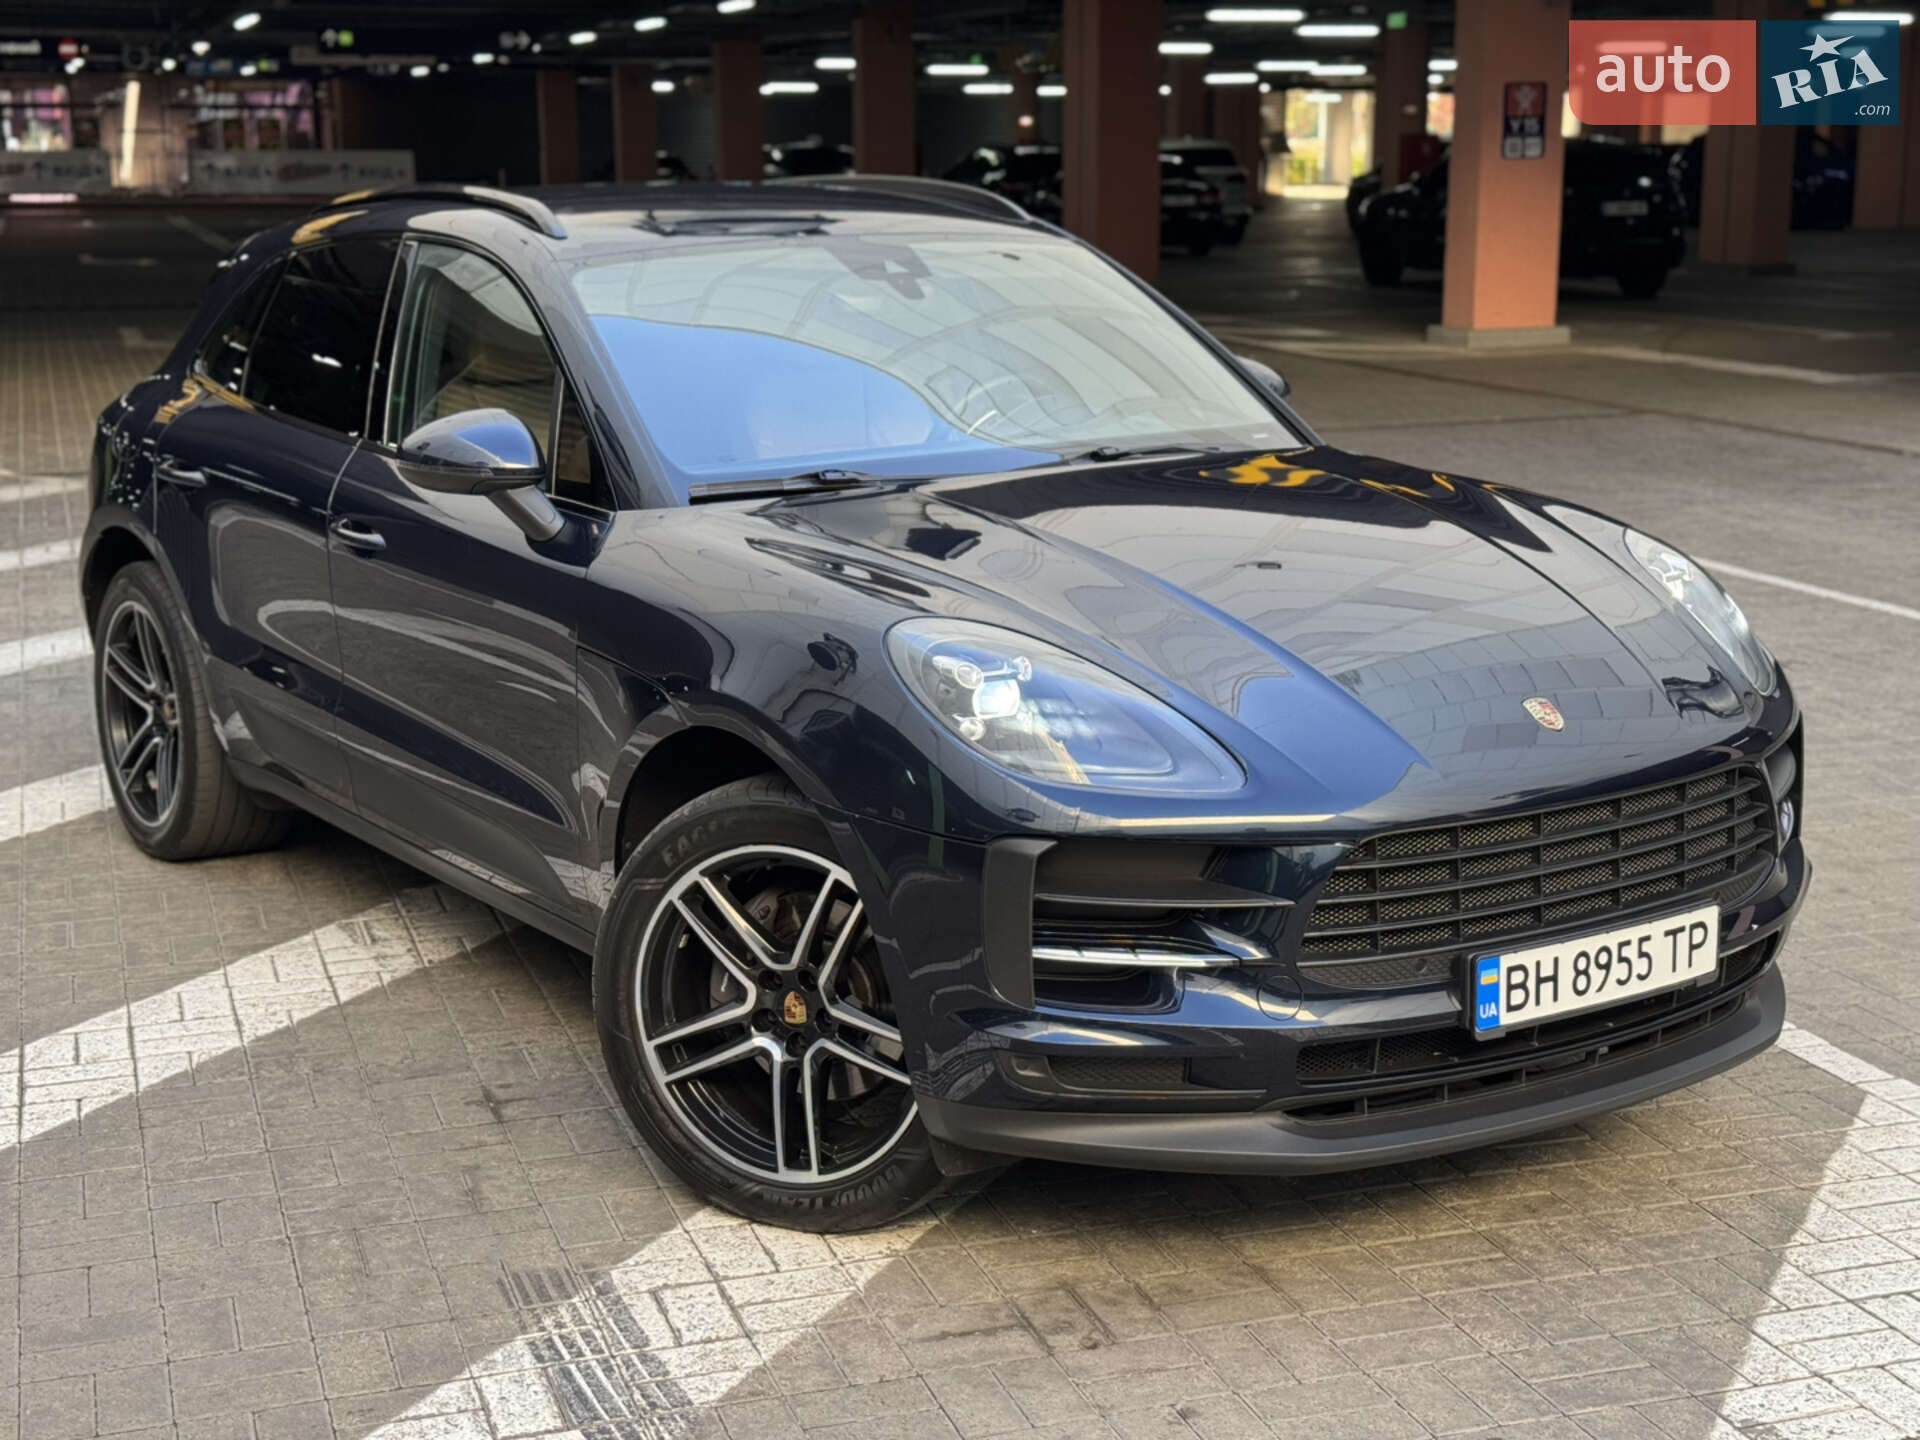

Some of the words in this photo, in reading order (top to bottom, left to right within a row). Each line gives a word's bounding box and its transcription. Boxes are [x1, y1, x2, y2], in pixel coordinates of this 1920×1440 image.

[1505, 956, 1559, 1013] BH
[1572, 935, 1652, 997] 8955
[1664, 920, 1708, 973] TP
[1480, 1002, 1498, 1018] UA
